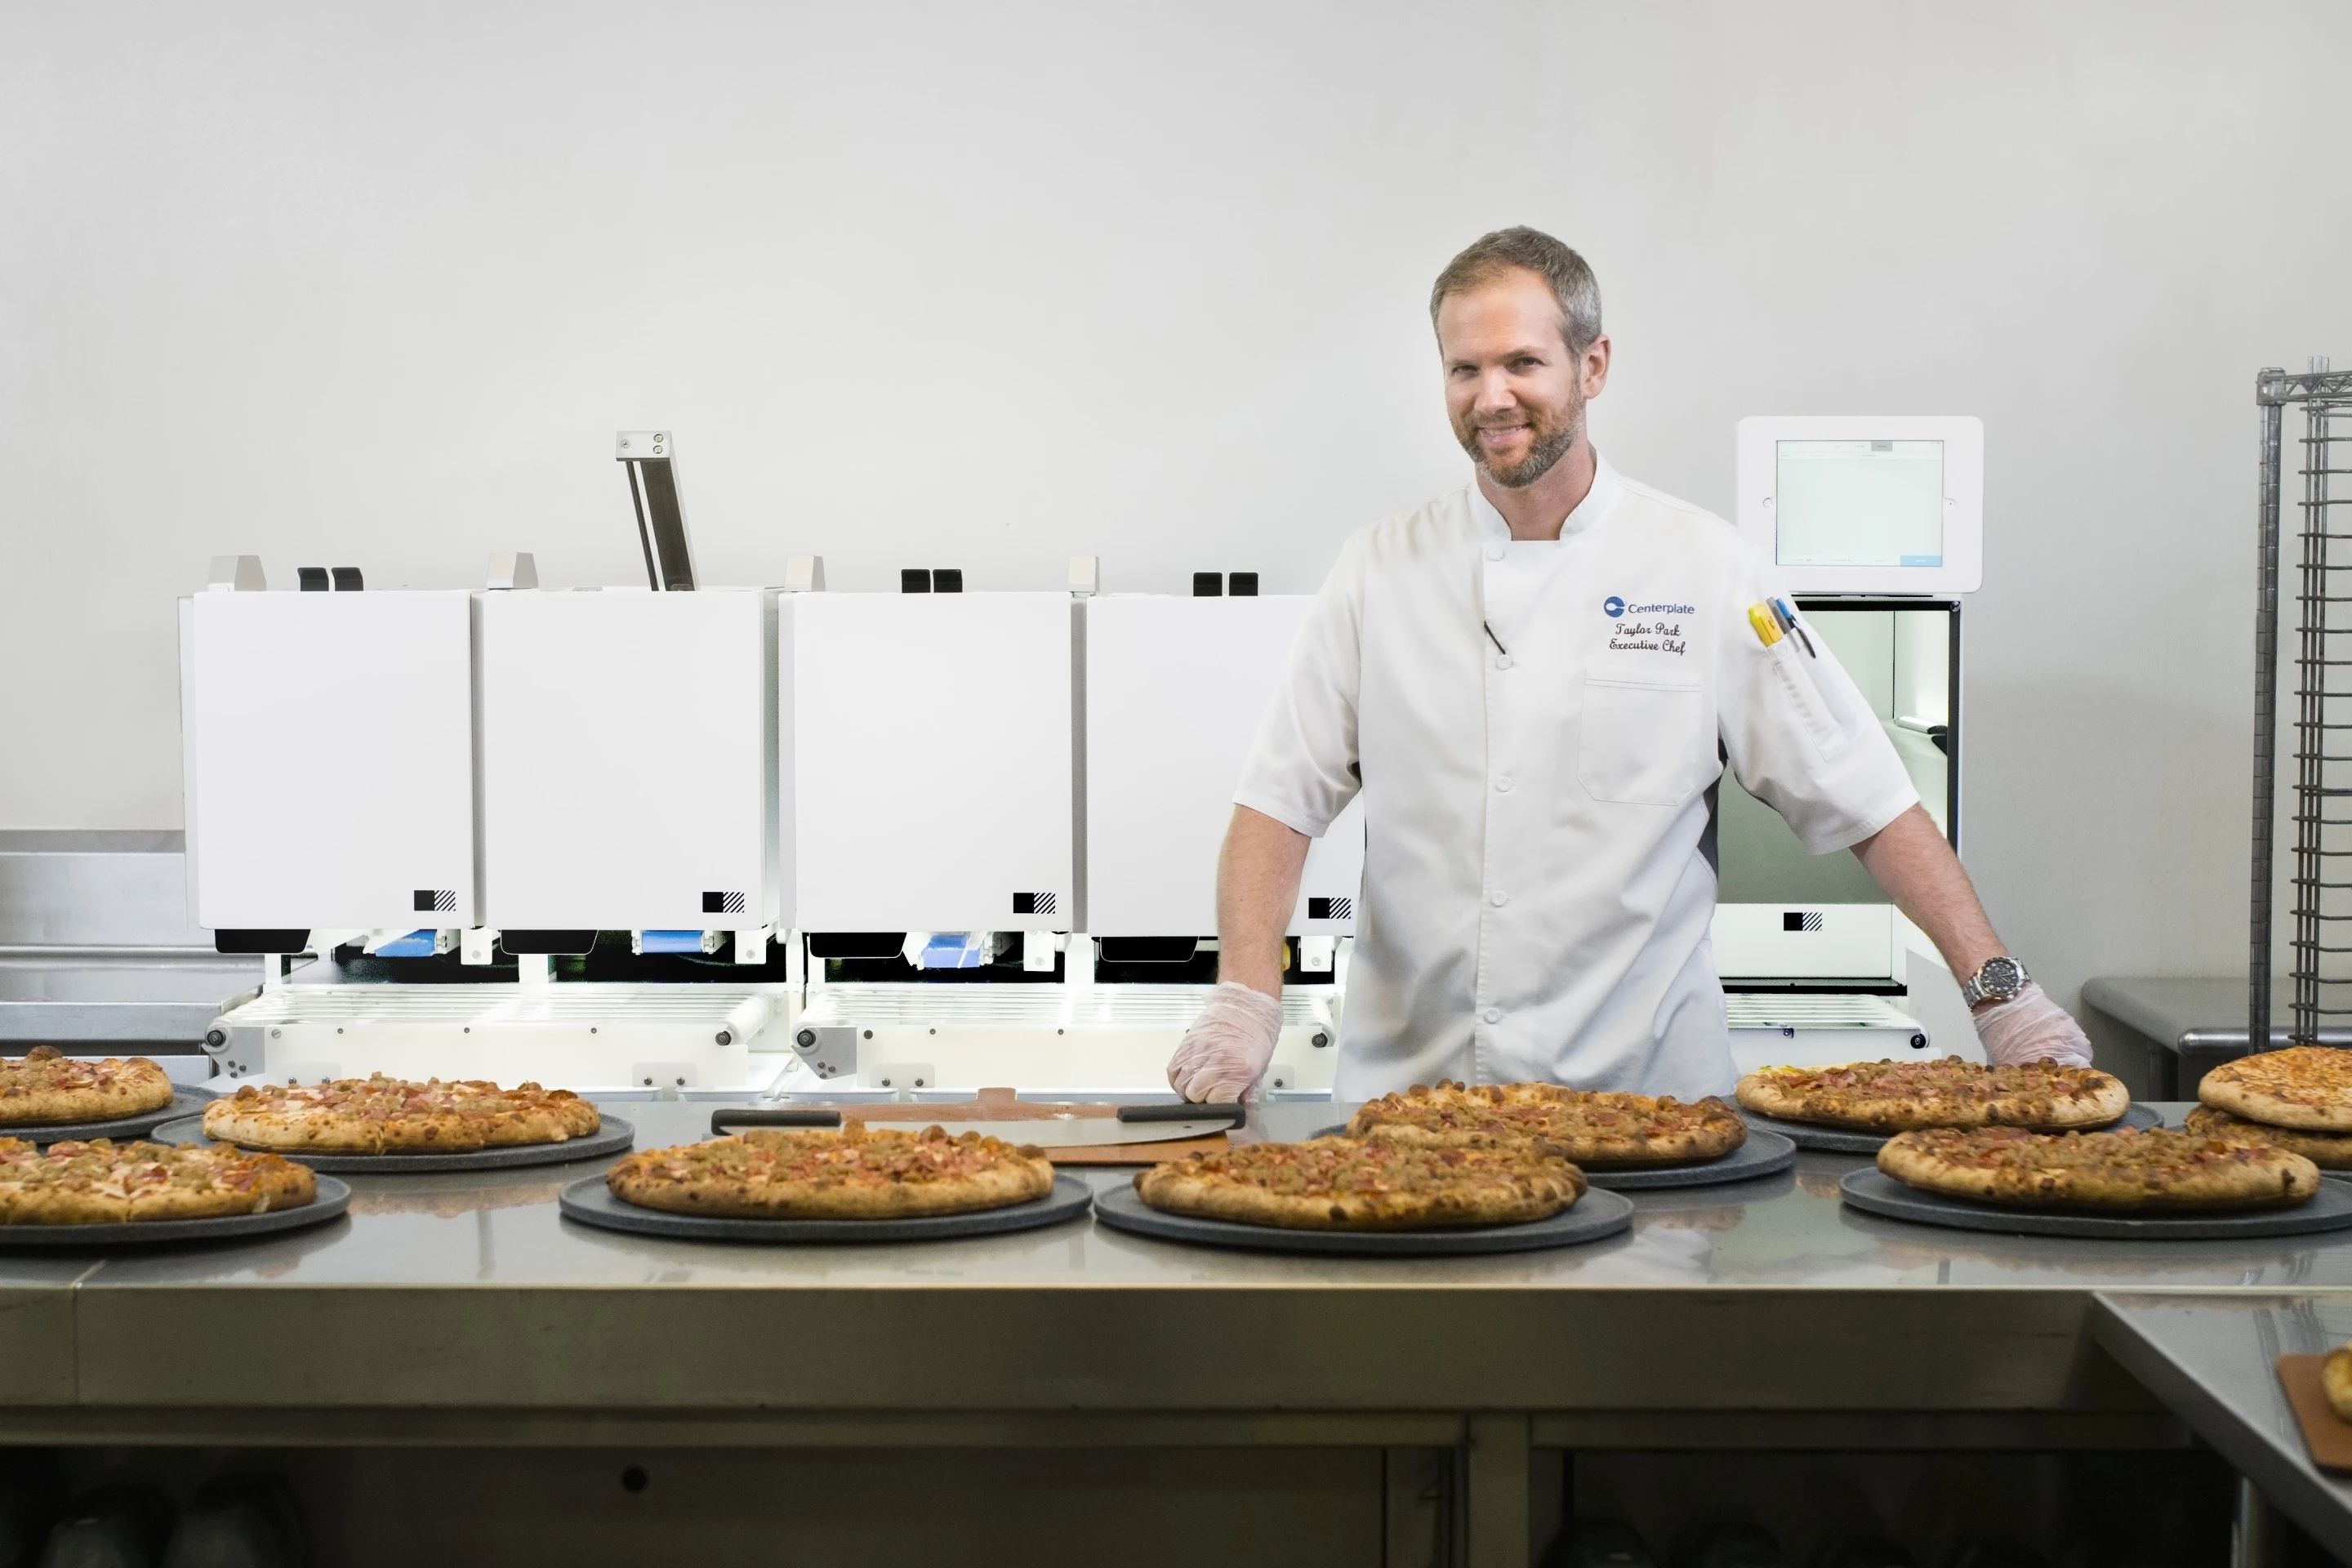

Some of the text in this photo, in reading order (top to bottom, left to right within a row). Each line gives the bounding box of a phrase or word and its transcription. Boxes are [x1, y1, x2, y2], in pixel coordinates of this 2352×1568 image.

[1628, 604, 1695, 614] Centerplate
[1615, 622, 1681, 637] Taylor Park
[1610, 639, 1686, 656] Executive Chef
